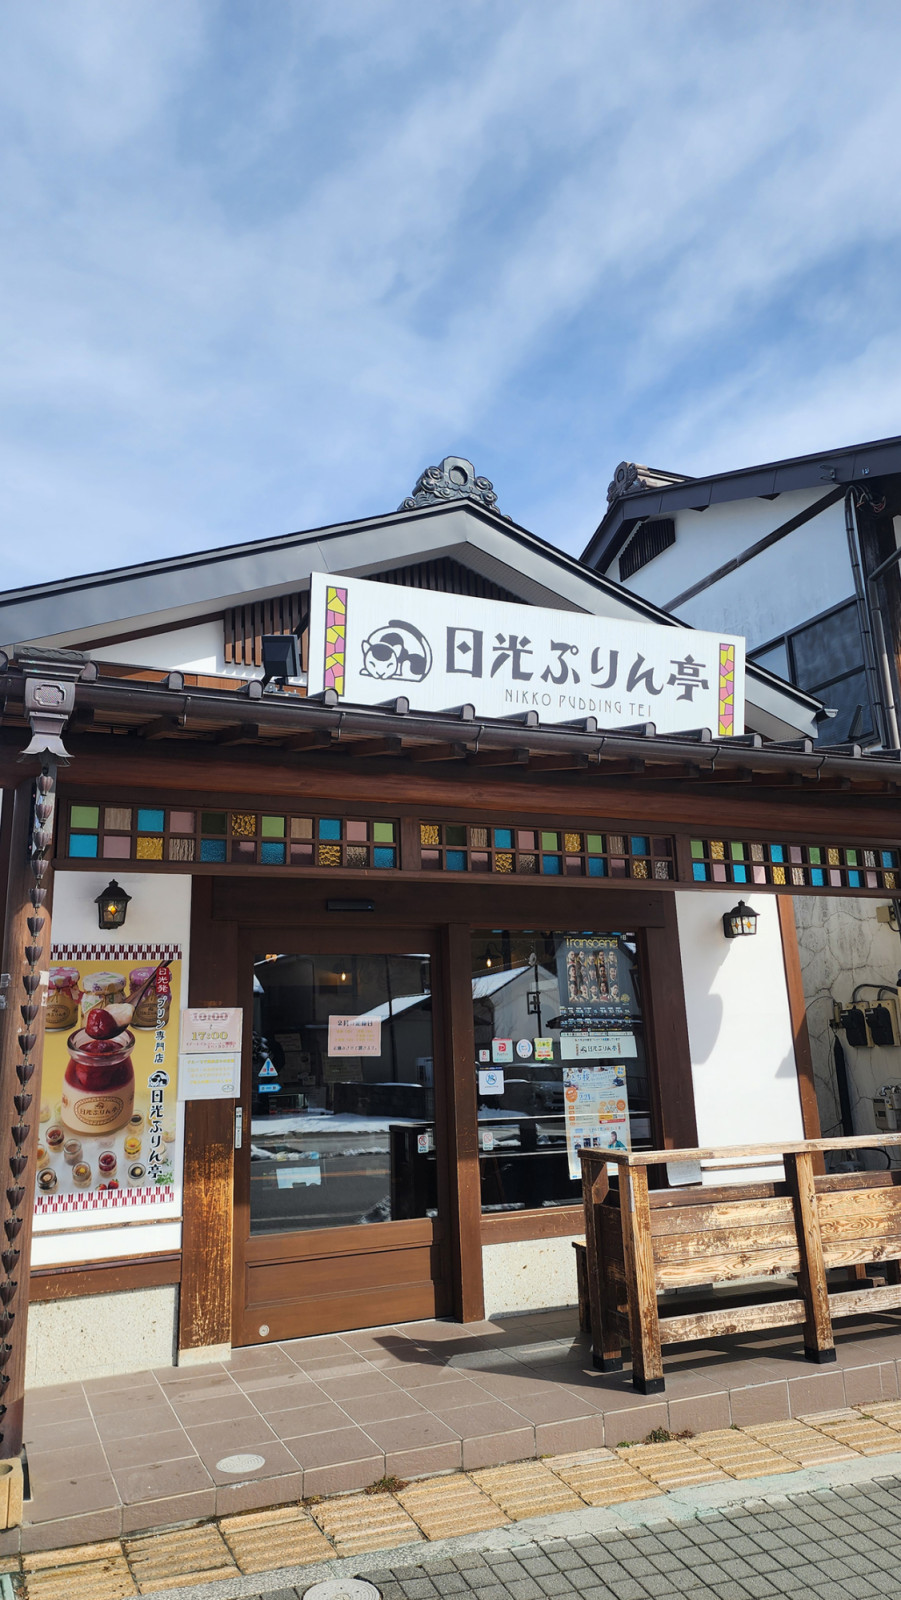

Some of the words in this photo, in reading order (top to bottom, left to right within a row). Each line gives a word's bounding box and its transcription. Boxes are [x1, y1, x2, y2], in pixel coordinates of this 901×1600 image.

[445, 626, 710, 703] 日光ぷりん亭
[504, 689, 552, 708] NIKKO
[558, 694, 622, 715] PUDDING
[629, 703, 652, 718] TEI
[156, 967, 170, 993] 日光発
[154, 996, 168, 1064] プリン専門店
[192, 1012, 229, 1022] 10:00
[191, 1031, 229, 1041] 17:00
